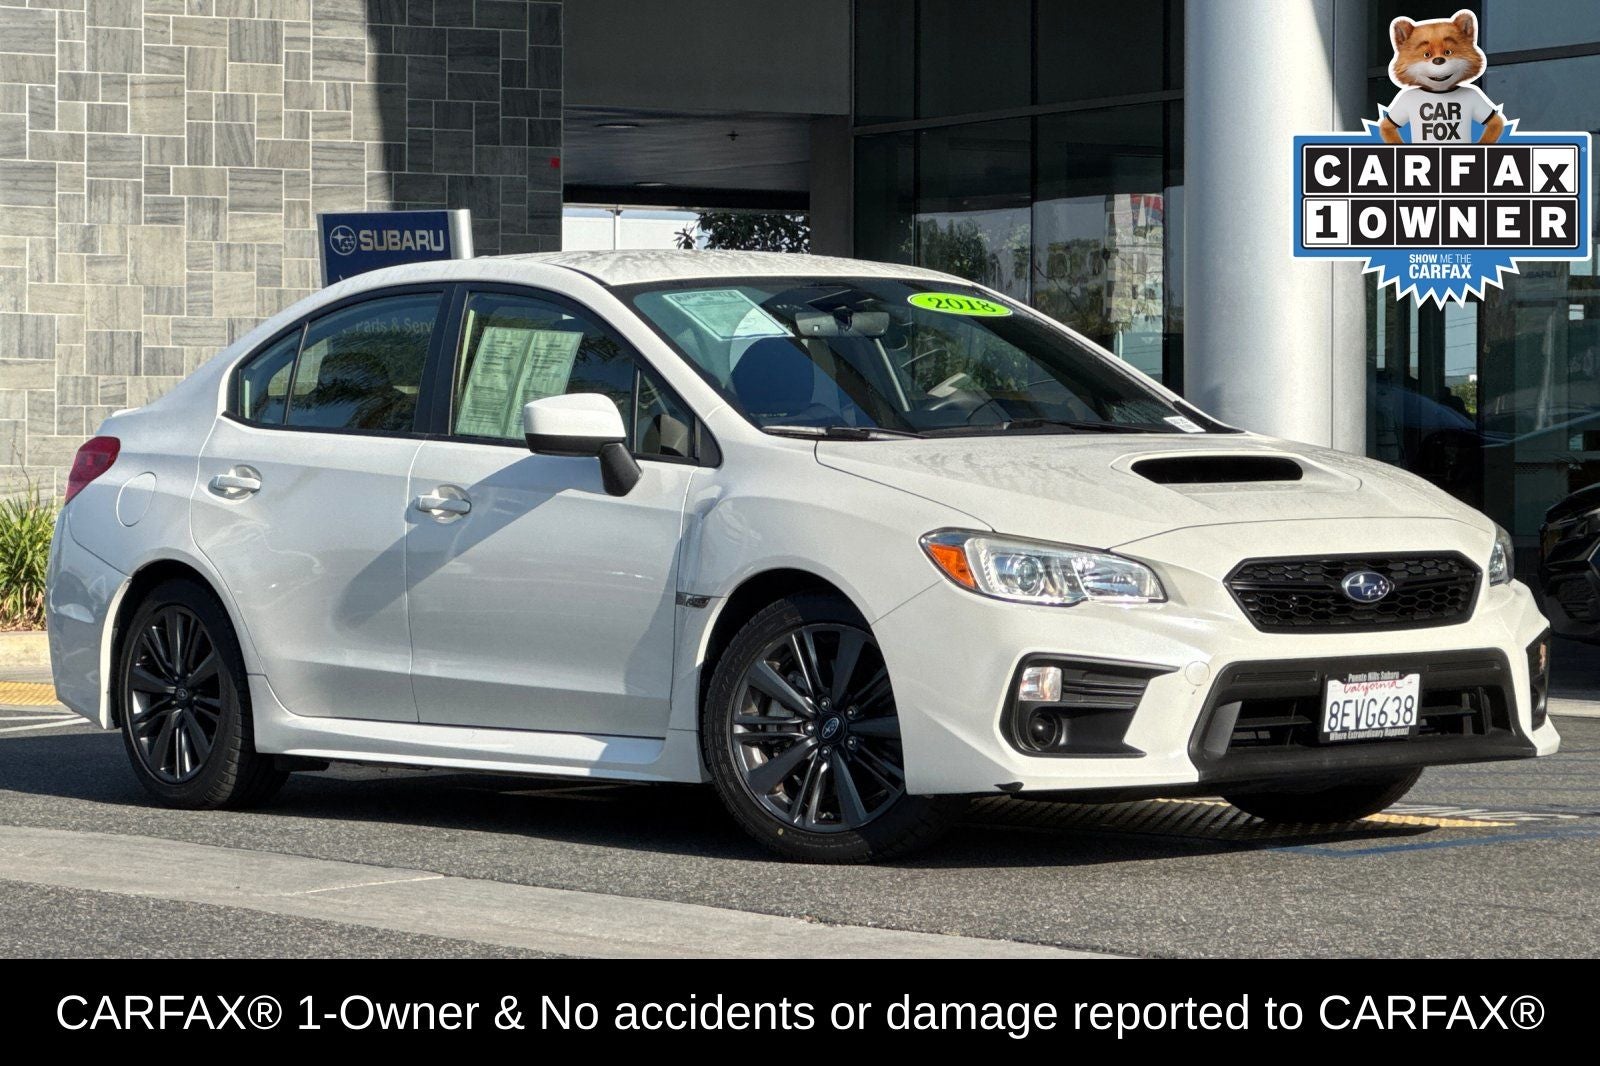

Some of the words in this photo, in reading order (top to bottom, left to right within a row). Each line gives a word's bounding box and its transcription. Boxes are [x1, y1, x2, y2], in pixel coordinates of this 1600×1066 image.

[359, 229, 445, 252] SUBARU
[927, 297, 997, 313] 2018
[1343, 680, 1403, 697] California
[1327, 695, 1415, 732] 8EVG638
